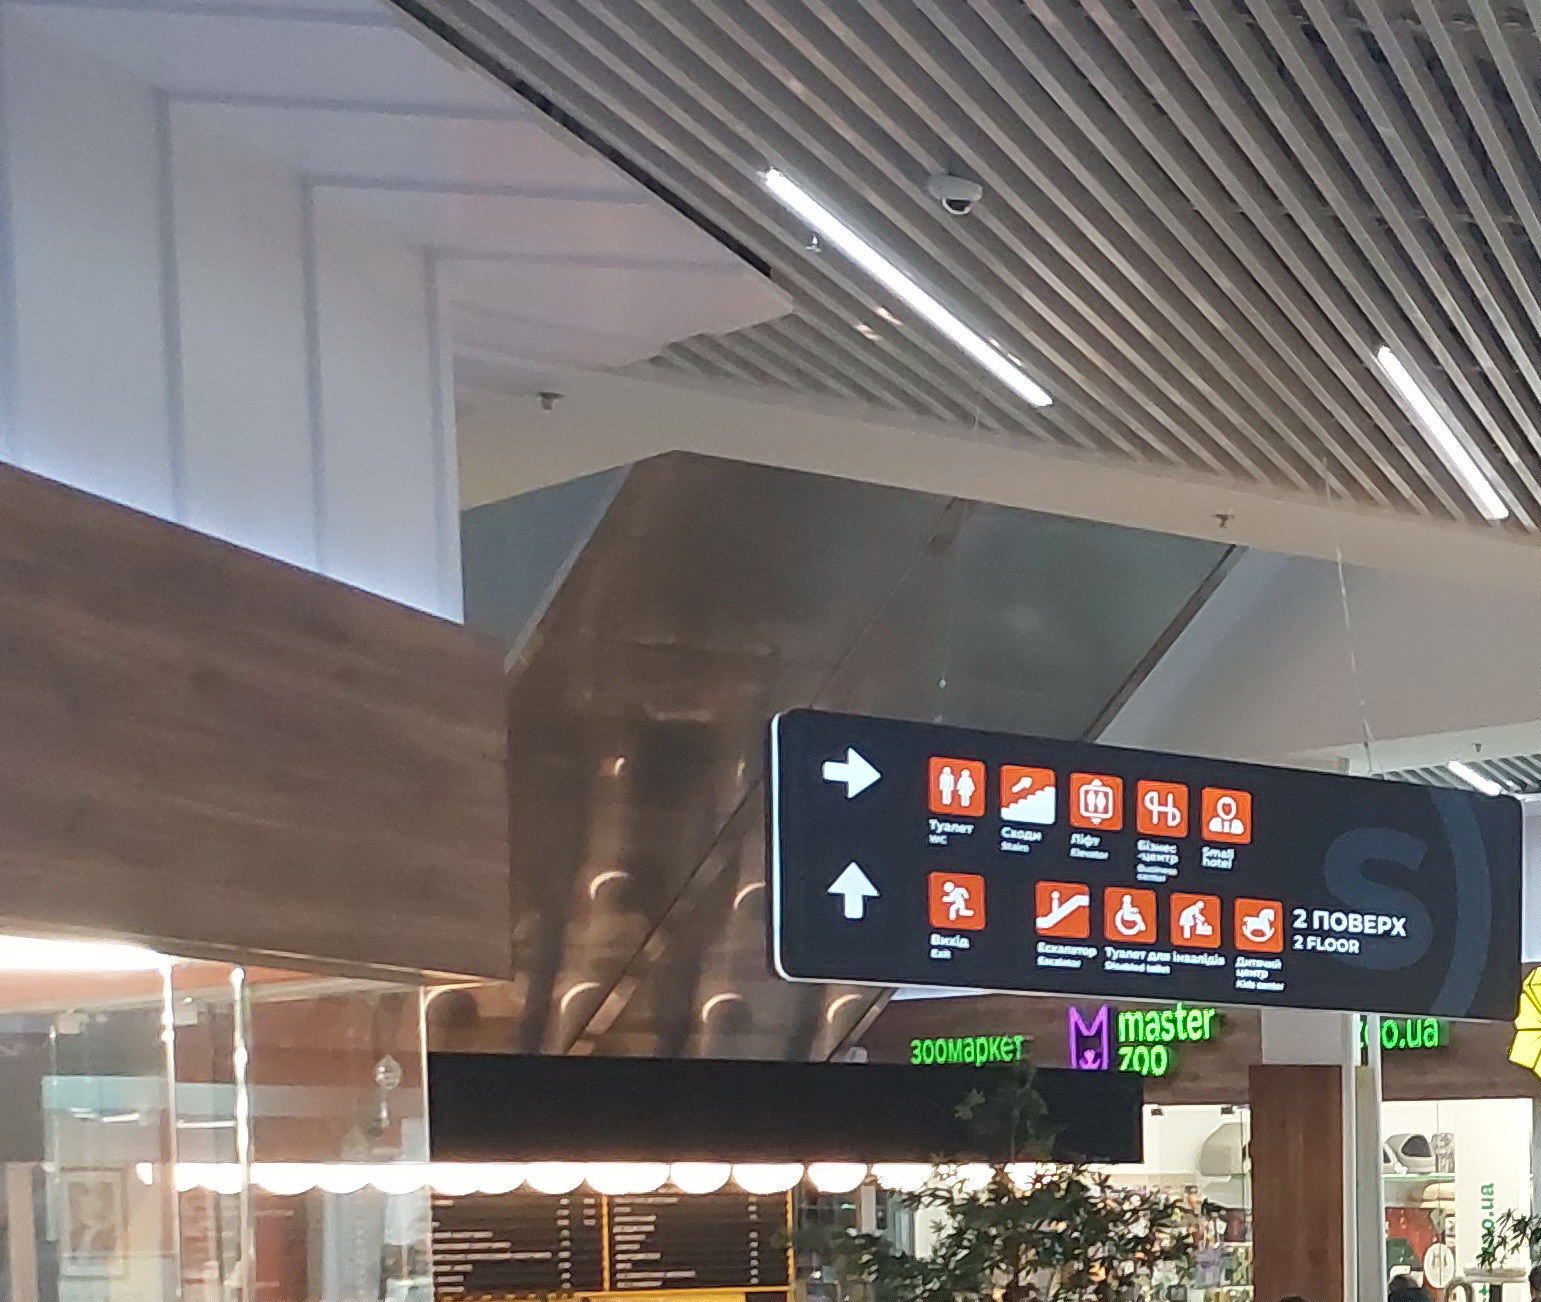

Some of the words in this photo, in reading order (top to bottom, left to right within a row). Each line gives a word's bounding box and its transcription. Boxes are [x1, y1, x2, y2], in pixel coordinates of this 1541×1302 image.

[928, 818, 975, 836] Туалет
[1202, 846, 1235, 860] Small
[1202, 857, 1233, 870] hotel
[1292, 909, 1307, 930] 2
[1312, 911, 1407, 937] ПОВЕРХ
[1292, 935, 1304, 950] 2
[1306, 936, 1361, 954] FLOOR
[1104, 946, 1146, 962] Туалет
[1117, 1002, 1216, 1042] master
[1117, 1044, 1169, 1076] zoo
